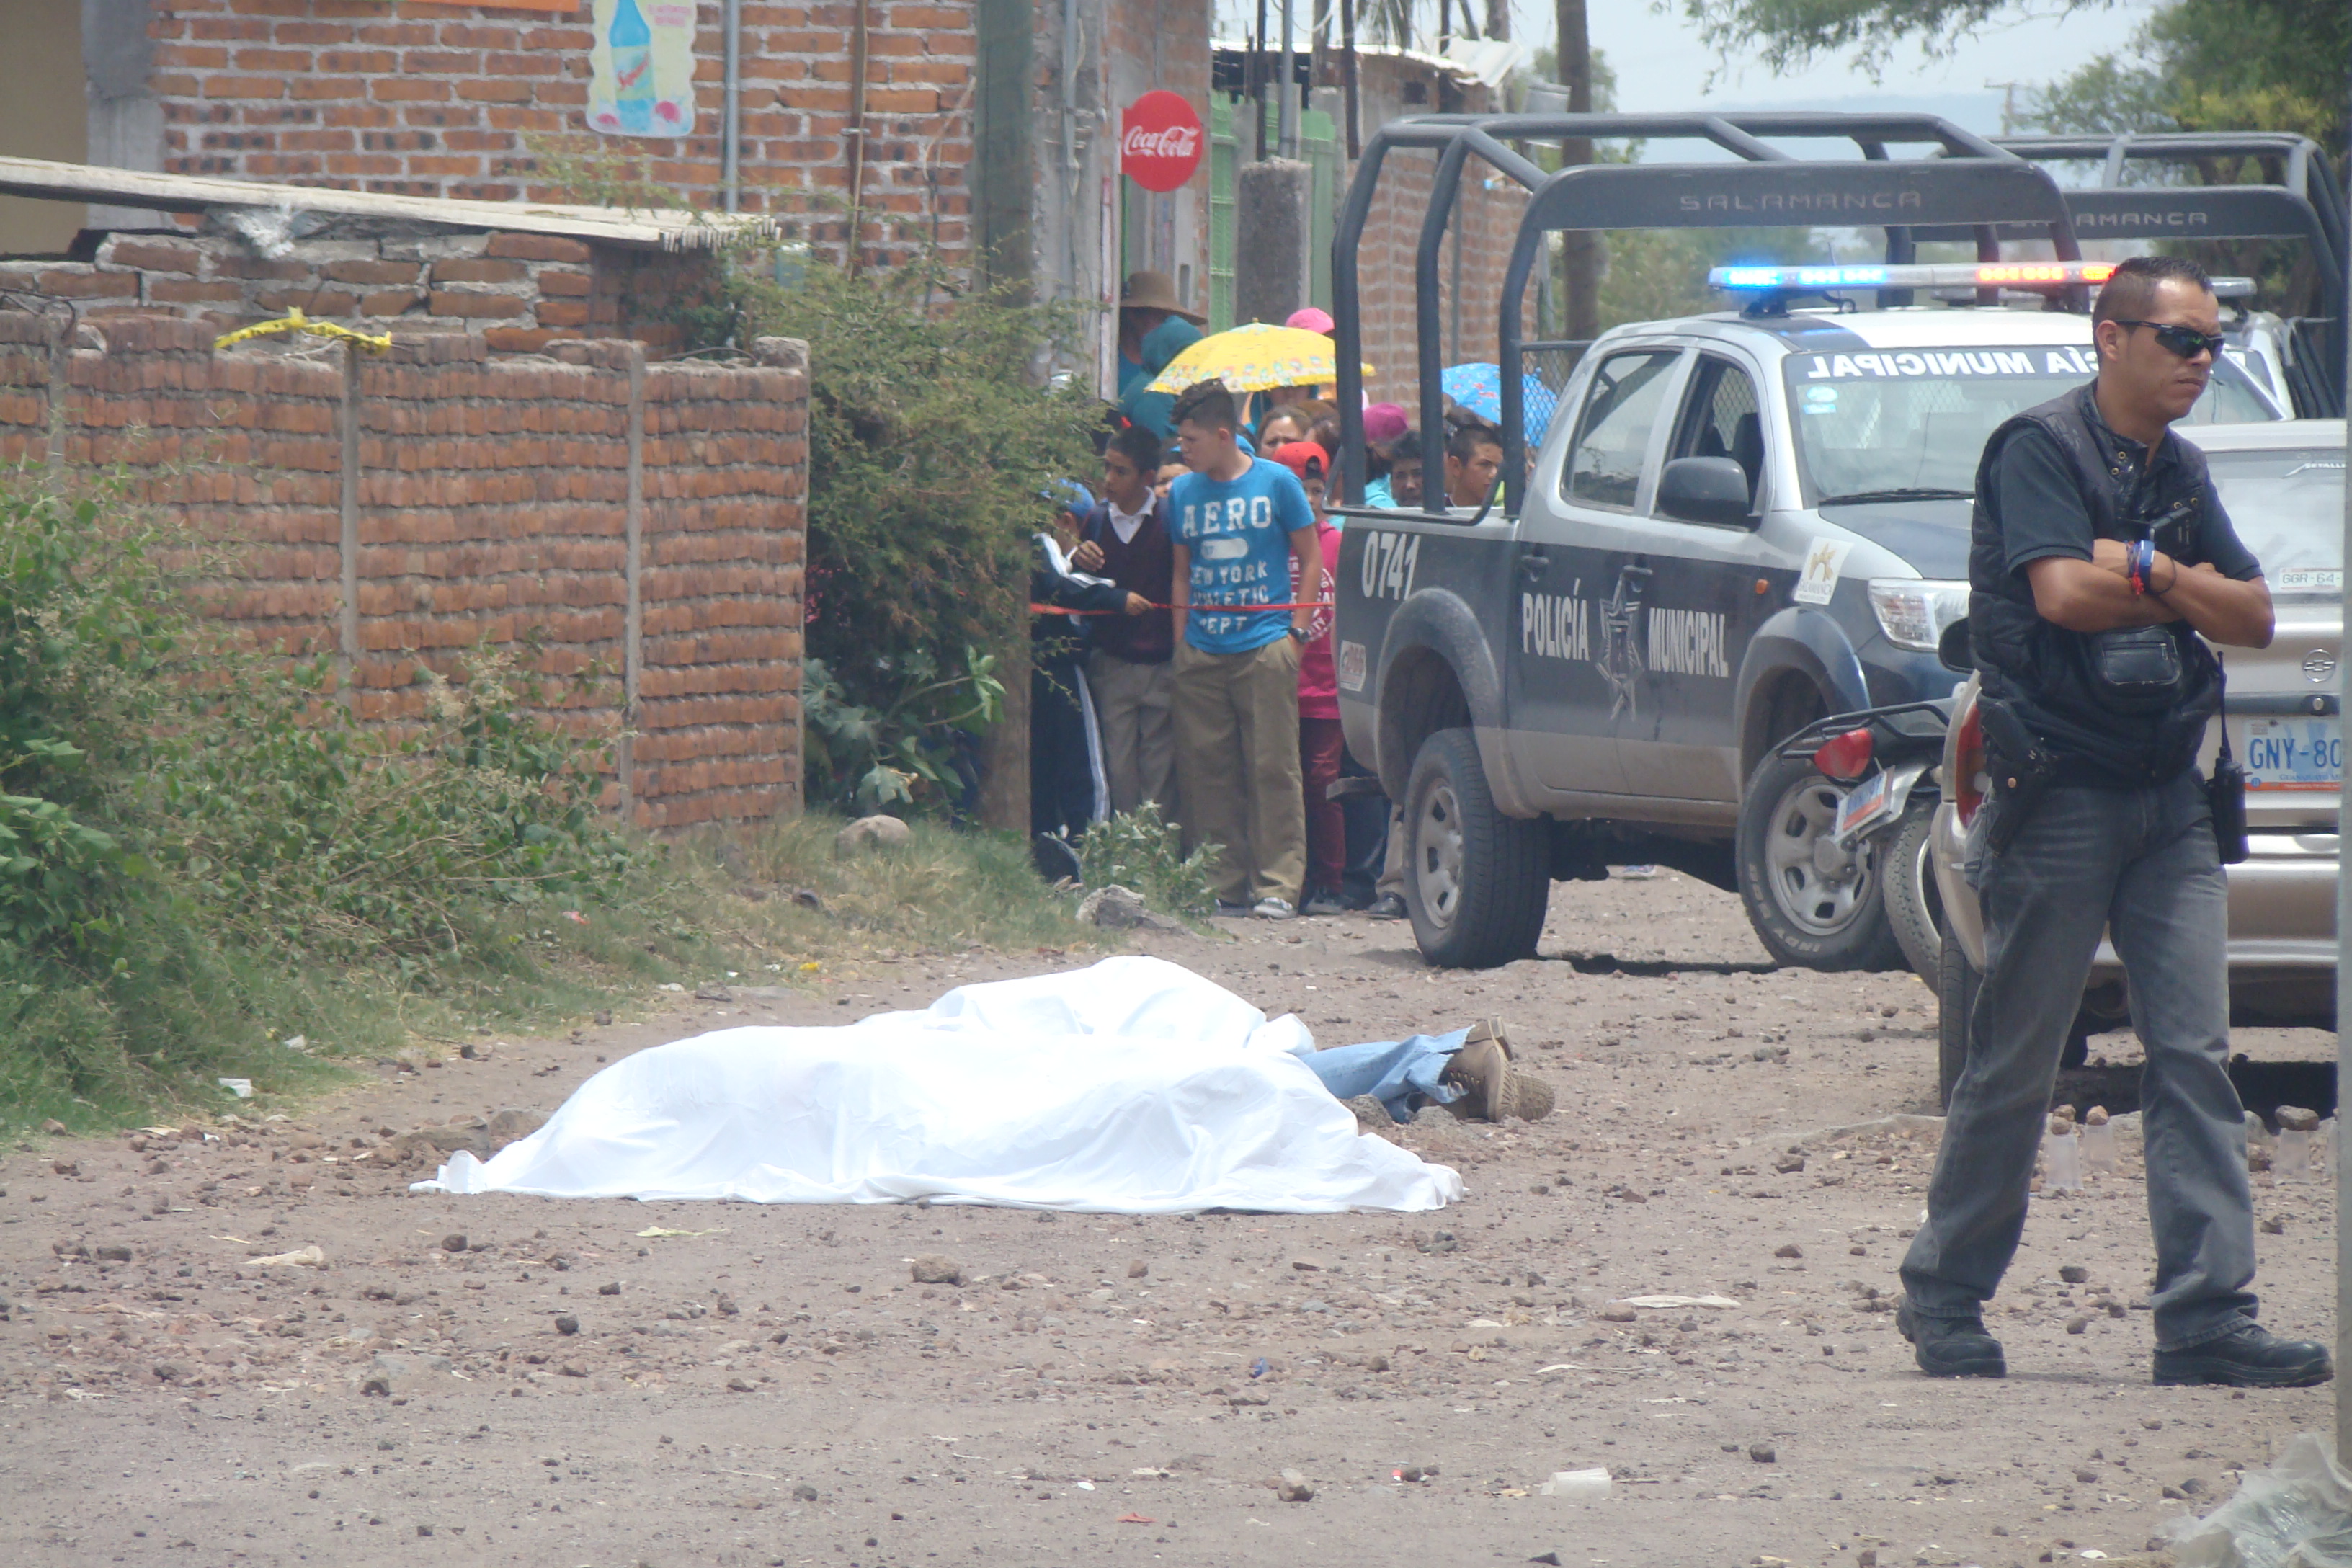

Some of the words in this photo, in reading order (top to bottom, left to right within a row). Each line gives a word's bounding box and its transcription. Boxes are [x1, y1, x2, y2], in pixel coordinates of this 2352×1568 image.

[1680, 190, 1922, 211] SALAMANCA
[1182, 496, 1272, 538] AERO
[1219, 560, 1268, 585] YORK
[1361, 530, 1420, 600] 0741
[1522, 578, 1590, 662] POLICÍA
[1647, 607, 1729, 678] MUNICIPAL
